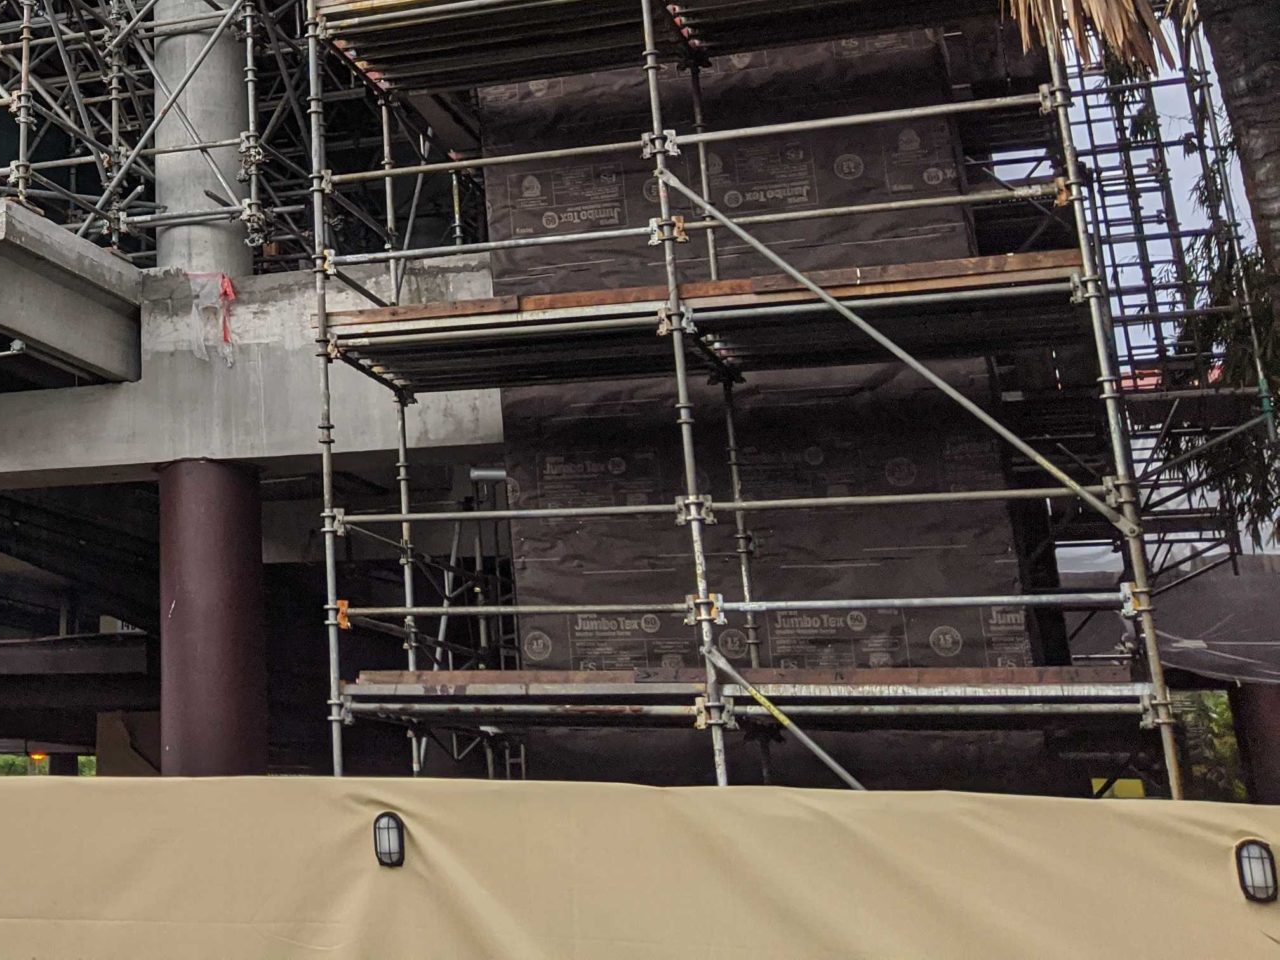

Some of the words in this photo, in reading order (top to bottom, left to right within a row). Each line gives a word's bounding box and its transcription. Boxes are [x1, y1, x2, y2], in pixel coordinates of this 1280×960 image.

[744, 191, 766, 202] Tex
[766, 186, 810, 199] Jumbo
[559, 211, 580, 223] Tex
[579, 206, 621, 221] Jumbo
[575, 616, 618, 631] Jumbo
[617, 617, 639, 630] Tex
[775, 613, 821, 628] Jumbo
[820, 614, 846, 628] Tex
